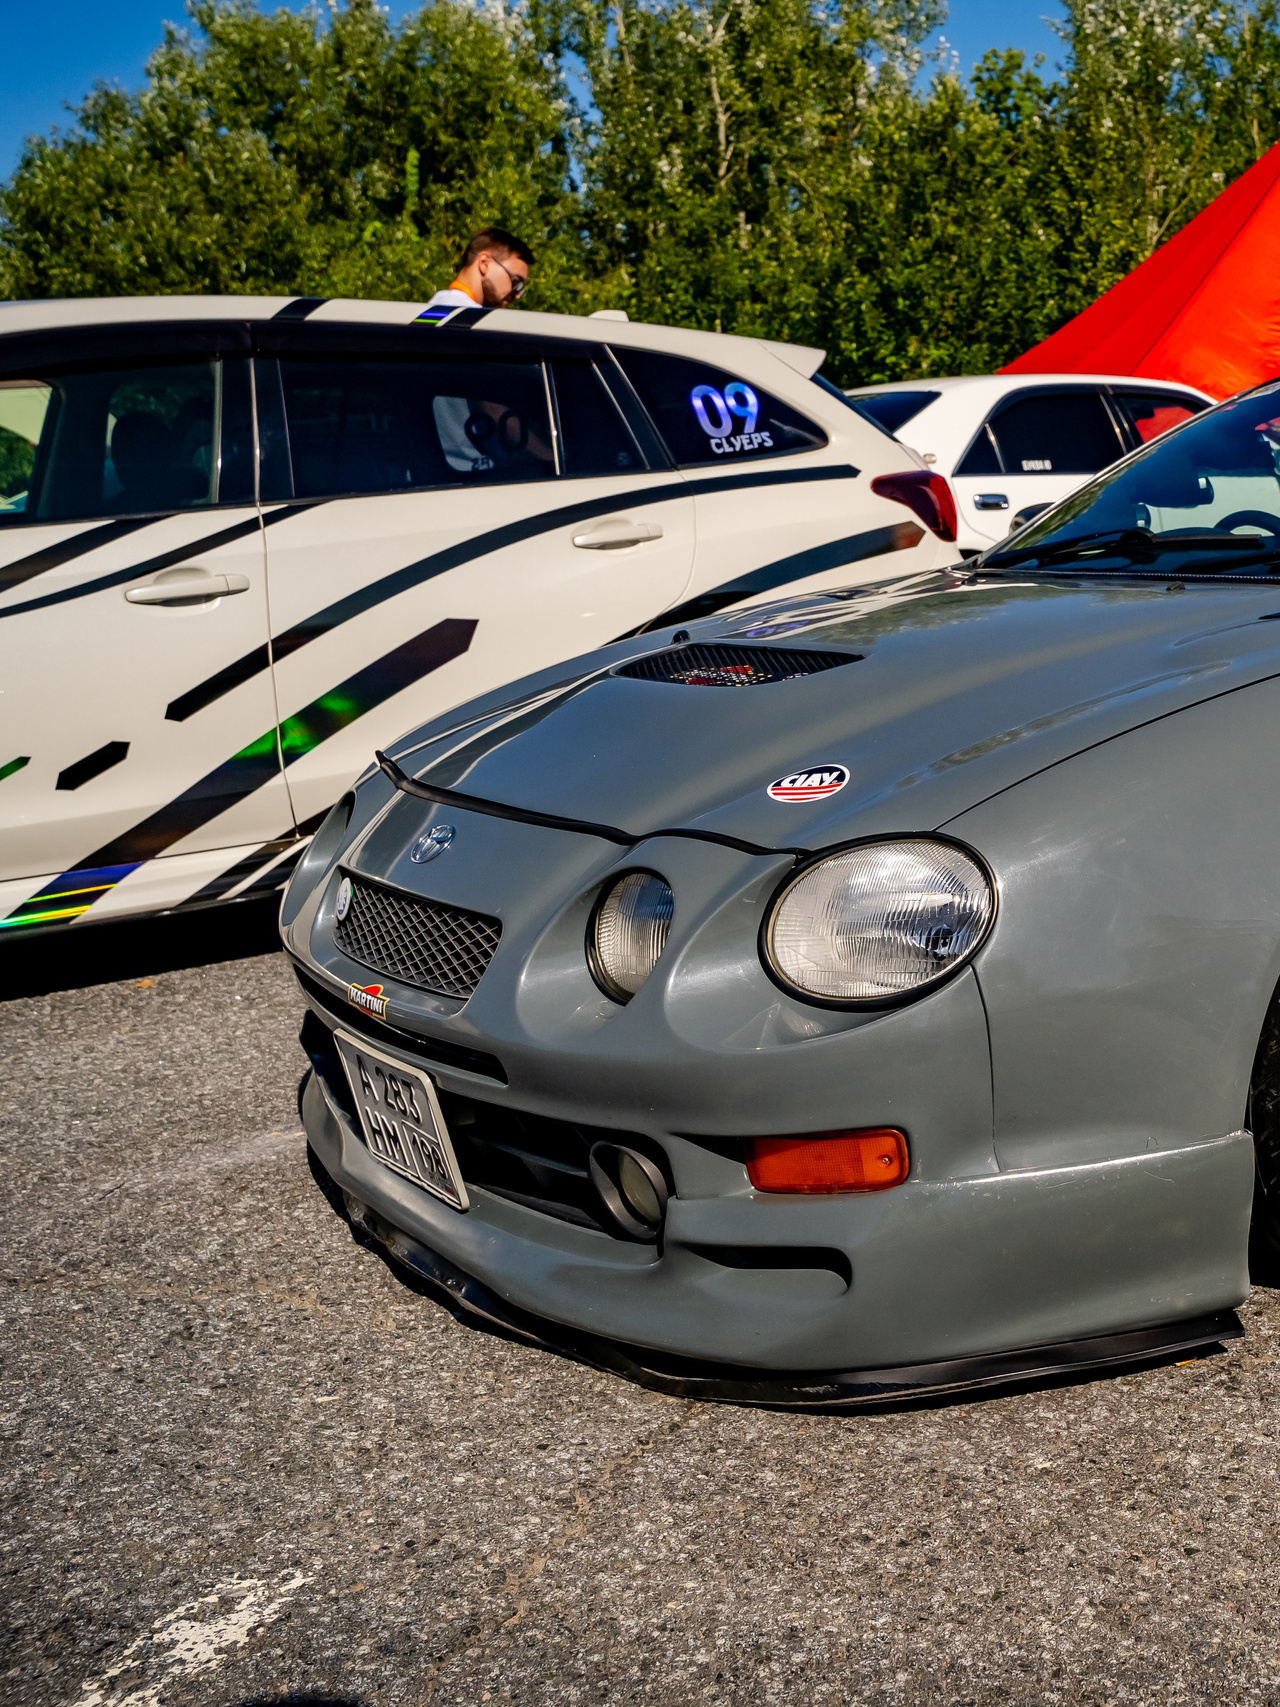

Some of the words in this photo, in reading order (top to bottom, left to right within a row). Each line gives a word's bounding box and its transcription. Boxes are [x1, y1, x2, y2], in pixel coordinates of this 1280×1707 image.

[690, 382, 759, 438] 09
[710, 431, 774, 454] CLYEPS
[350, 987, 384, 1014] MARTINI
[374, 1066, 422, 1125] 283
[412, 1132, 449, 1180] 198
